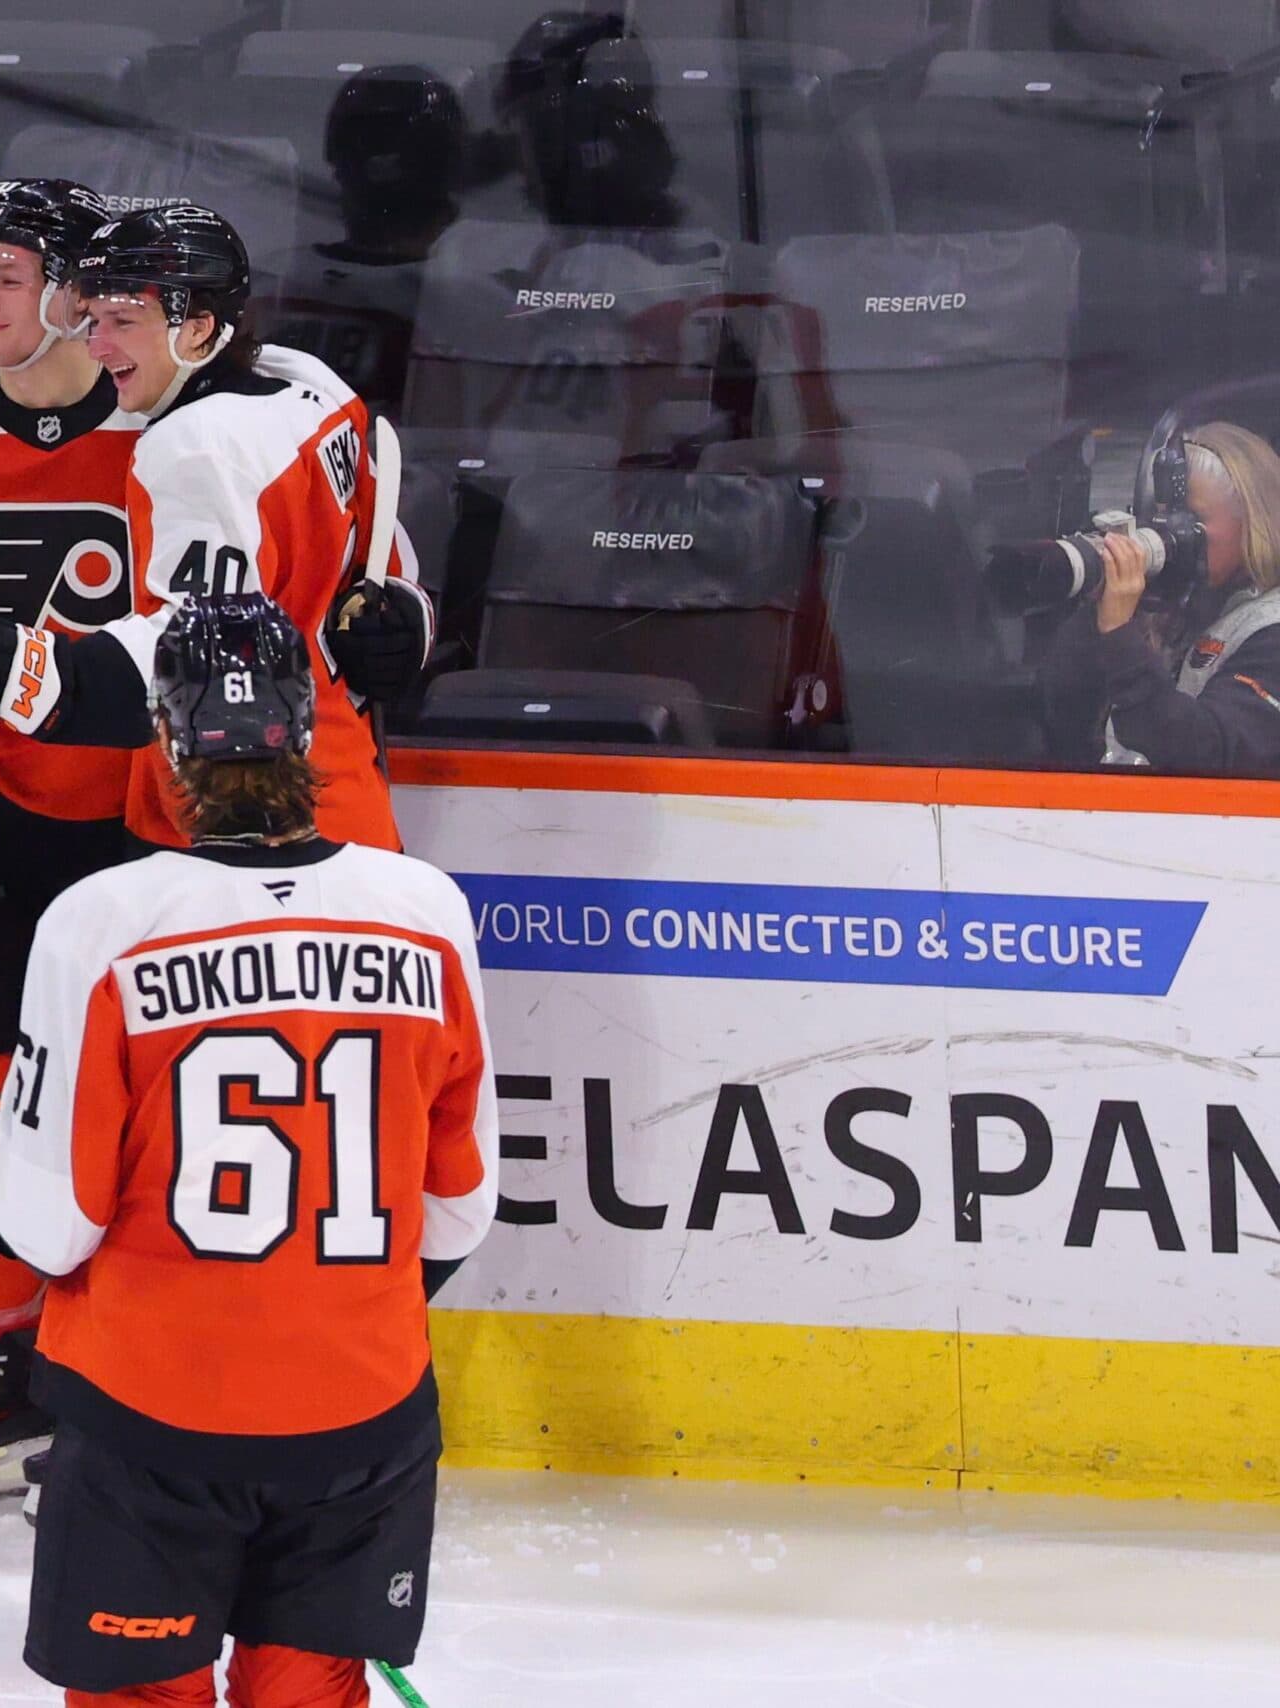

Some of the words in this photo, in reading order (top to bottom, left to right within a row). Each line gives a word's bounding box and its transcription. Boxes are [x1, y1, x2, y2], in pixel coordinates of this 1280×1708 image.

[79, 256, 106, 269] CCM
[516, 290, 615, 310] RESERVED
[865, 293, 966, 314] RESERVED
[592, 530, 694, 551] RESERVED
[169, 540, 249, 596] 40
[223, 671, 255, 704] 61
[625, 908, 903, 957] CONNECTED
[918, 921, 950, 960] &
[962, 922, 1143, 968] SECURE
[135, 941, 437, 1021] SOKOLOVSKII
[167, 1028, 391, 1265] 61
[88, 1612, 196, 1640] CCM
